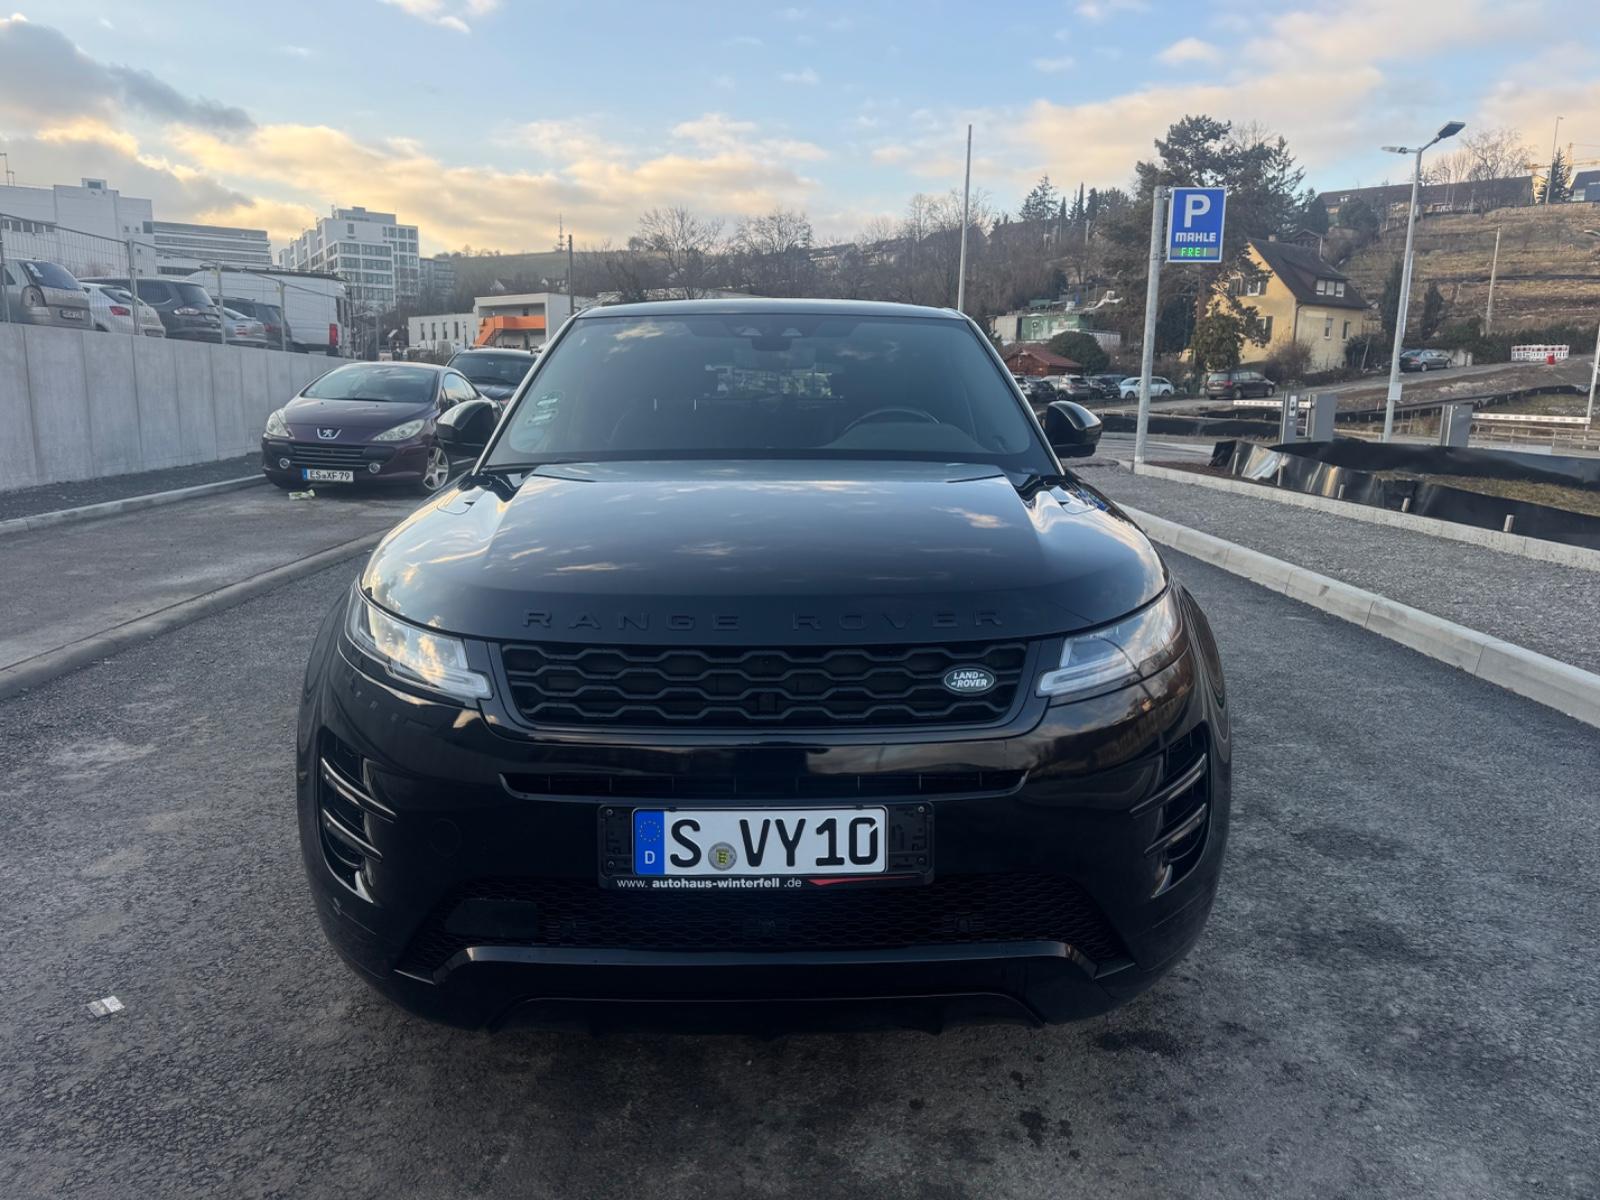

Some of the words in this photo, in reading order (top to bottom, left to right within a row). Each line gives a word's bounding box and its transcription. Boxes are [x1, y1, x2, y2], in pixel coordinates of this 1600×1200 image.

[1183, 194, 1211, 228] P
[1175, 232, 1217, 243] MAHLE
[1181, 247, 1207, 257] FREI
[522, 608, 742, 631] RANGE
[792, 610, 1002, 631] ROVER
[669, 819, 702, 868] S
[644, 851, 655, 865] D
[652, 878, 780, 889] autohaus-winterfell
